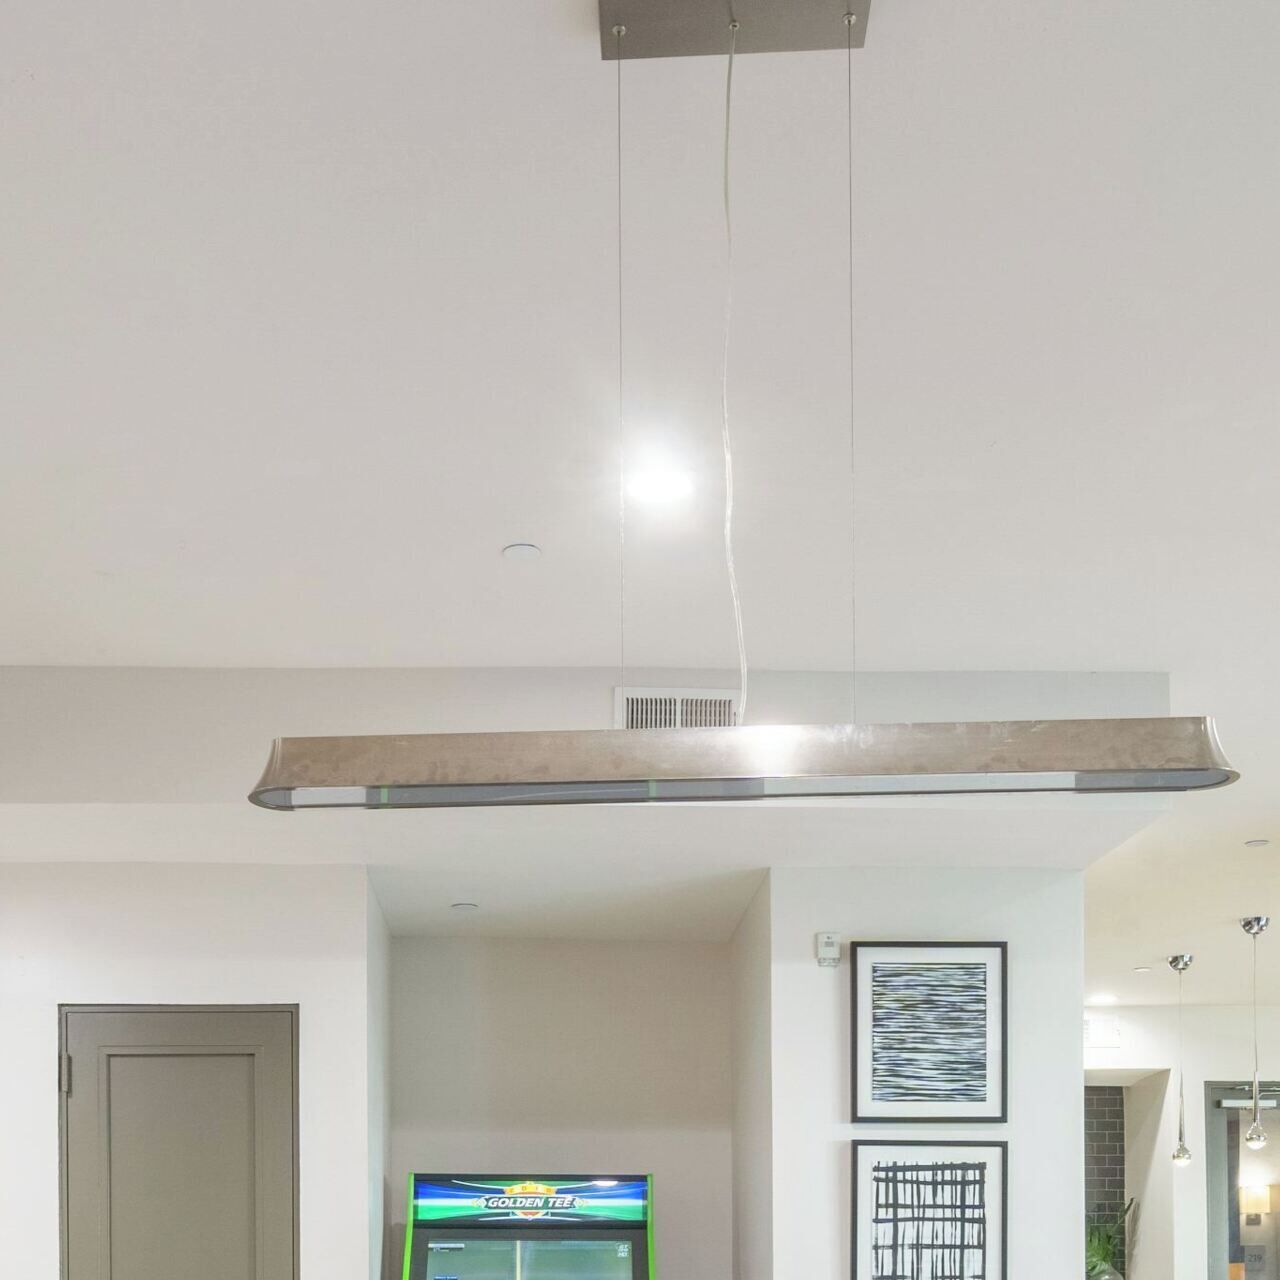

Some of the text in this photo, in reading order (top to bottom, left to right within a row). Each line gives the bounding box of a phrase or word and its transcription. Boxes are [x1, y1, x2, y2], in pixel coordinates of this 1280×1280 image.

[488, 1197, 573, 1208] GOLDEN TEE
[1247, 1254, 1263, 1263] 219
